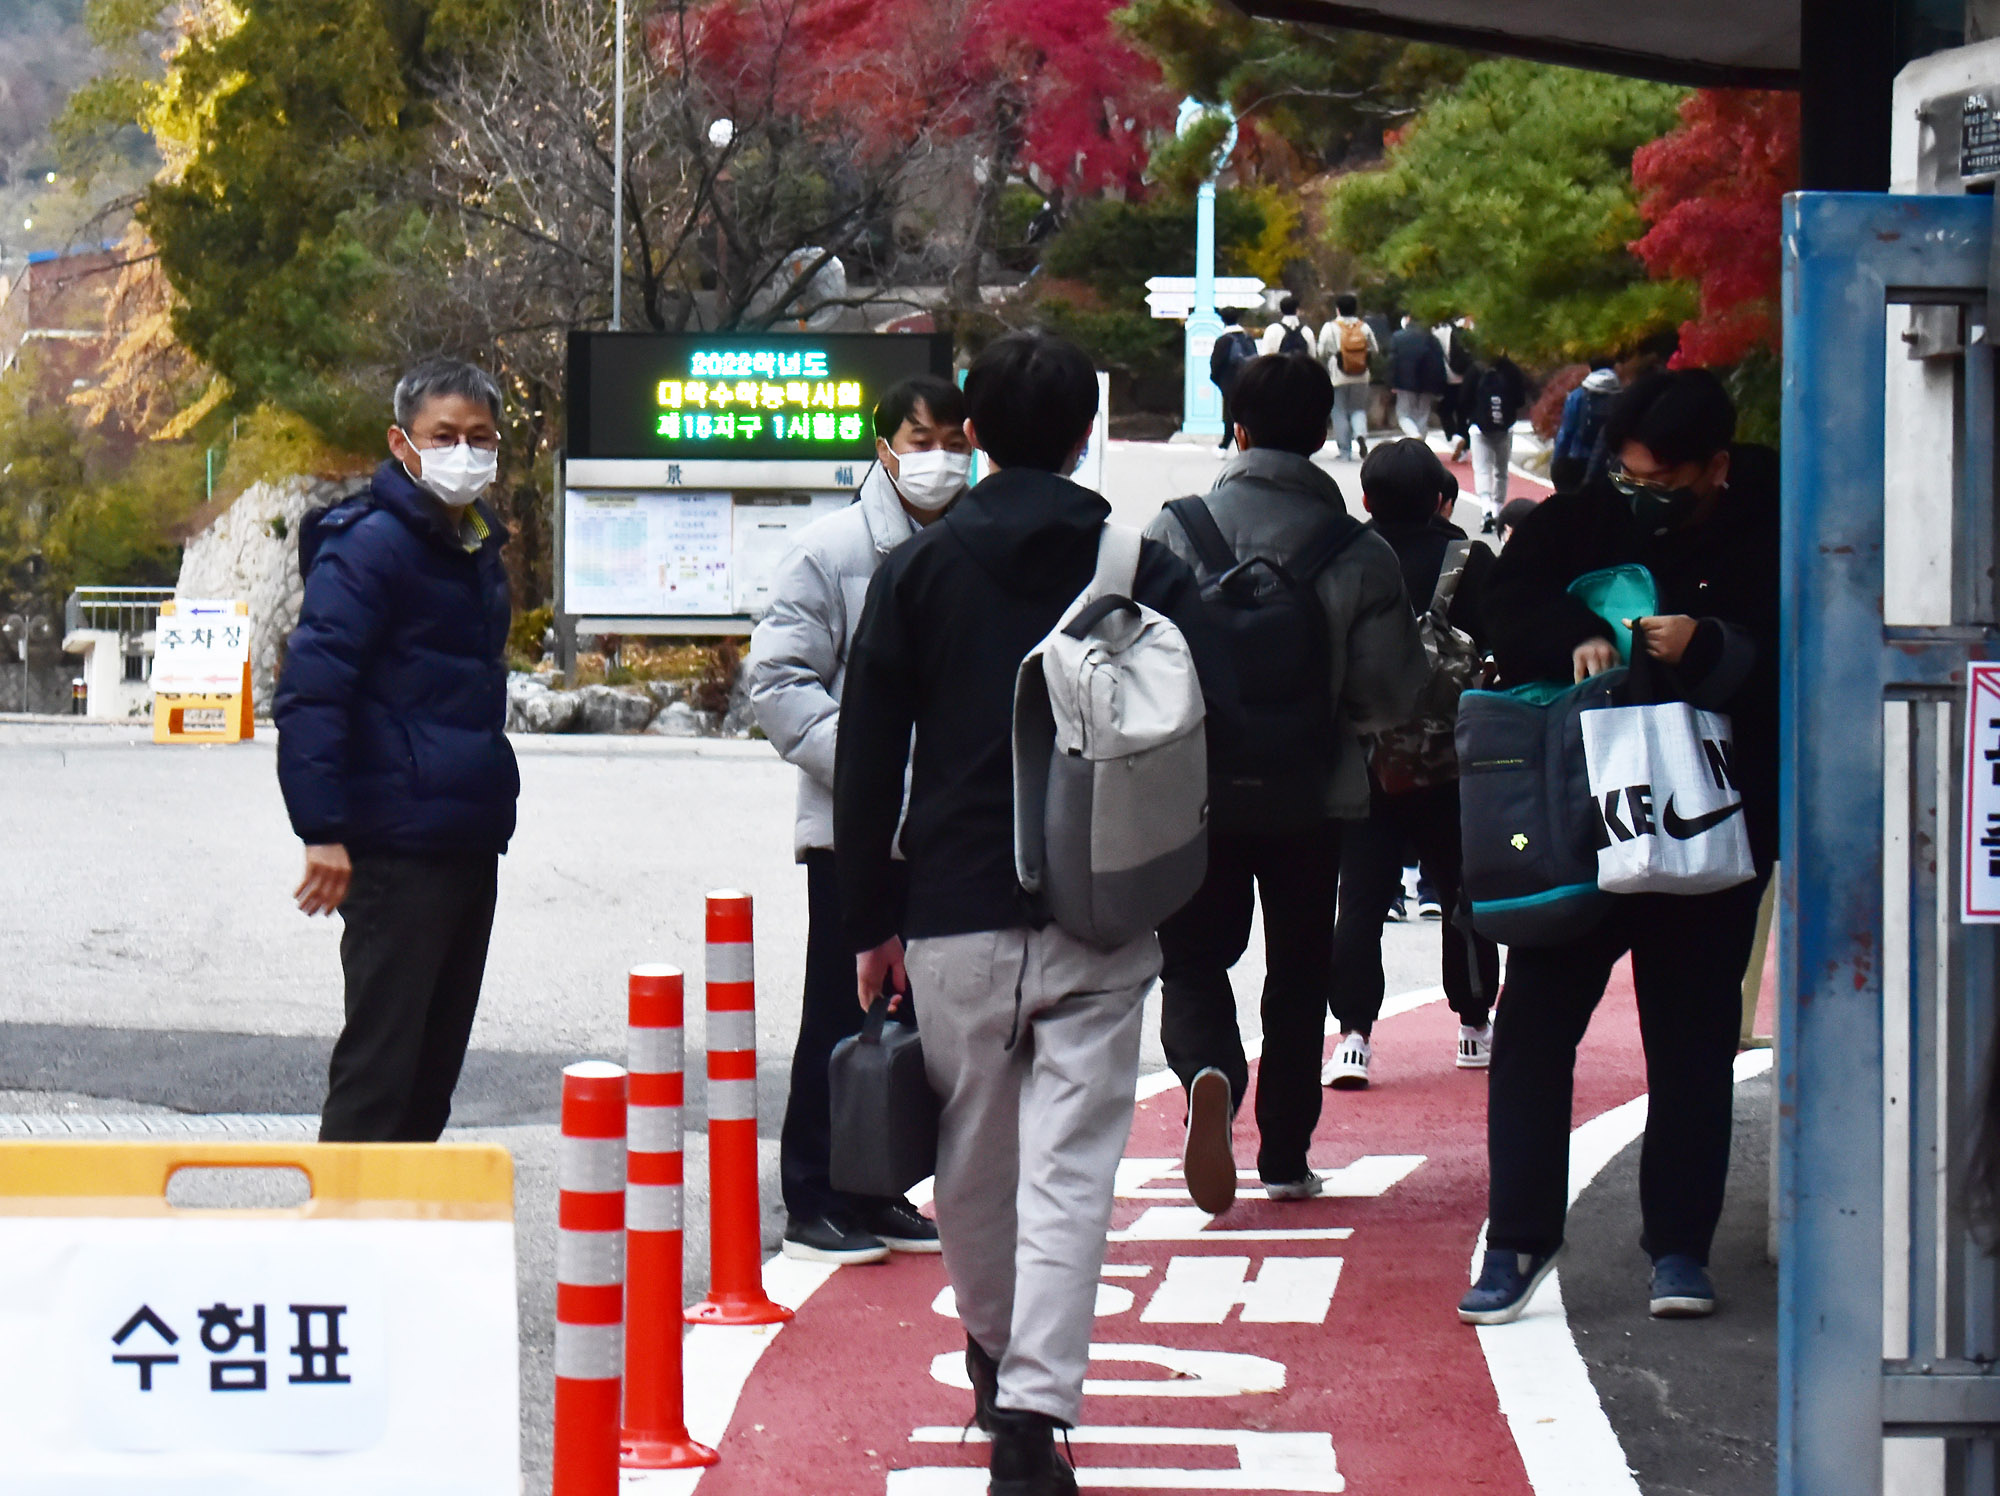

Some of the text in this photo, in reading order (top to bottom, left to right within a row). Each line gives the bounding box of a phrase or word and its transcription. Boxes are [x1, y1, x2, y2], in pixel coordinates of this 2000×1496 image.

[690, 351, 829, 380] 2022학년도
[657, 381, 862, 410] 대학수학능력시험
[772, 412, 864, 440] 1시험장
[160, 625, 242, 650] 주차장
[111, 1302, 351, 1392] 수험표
